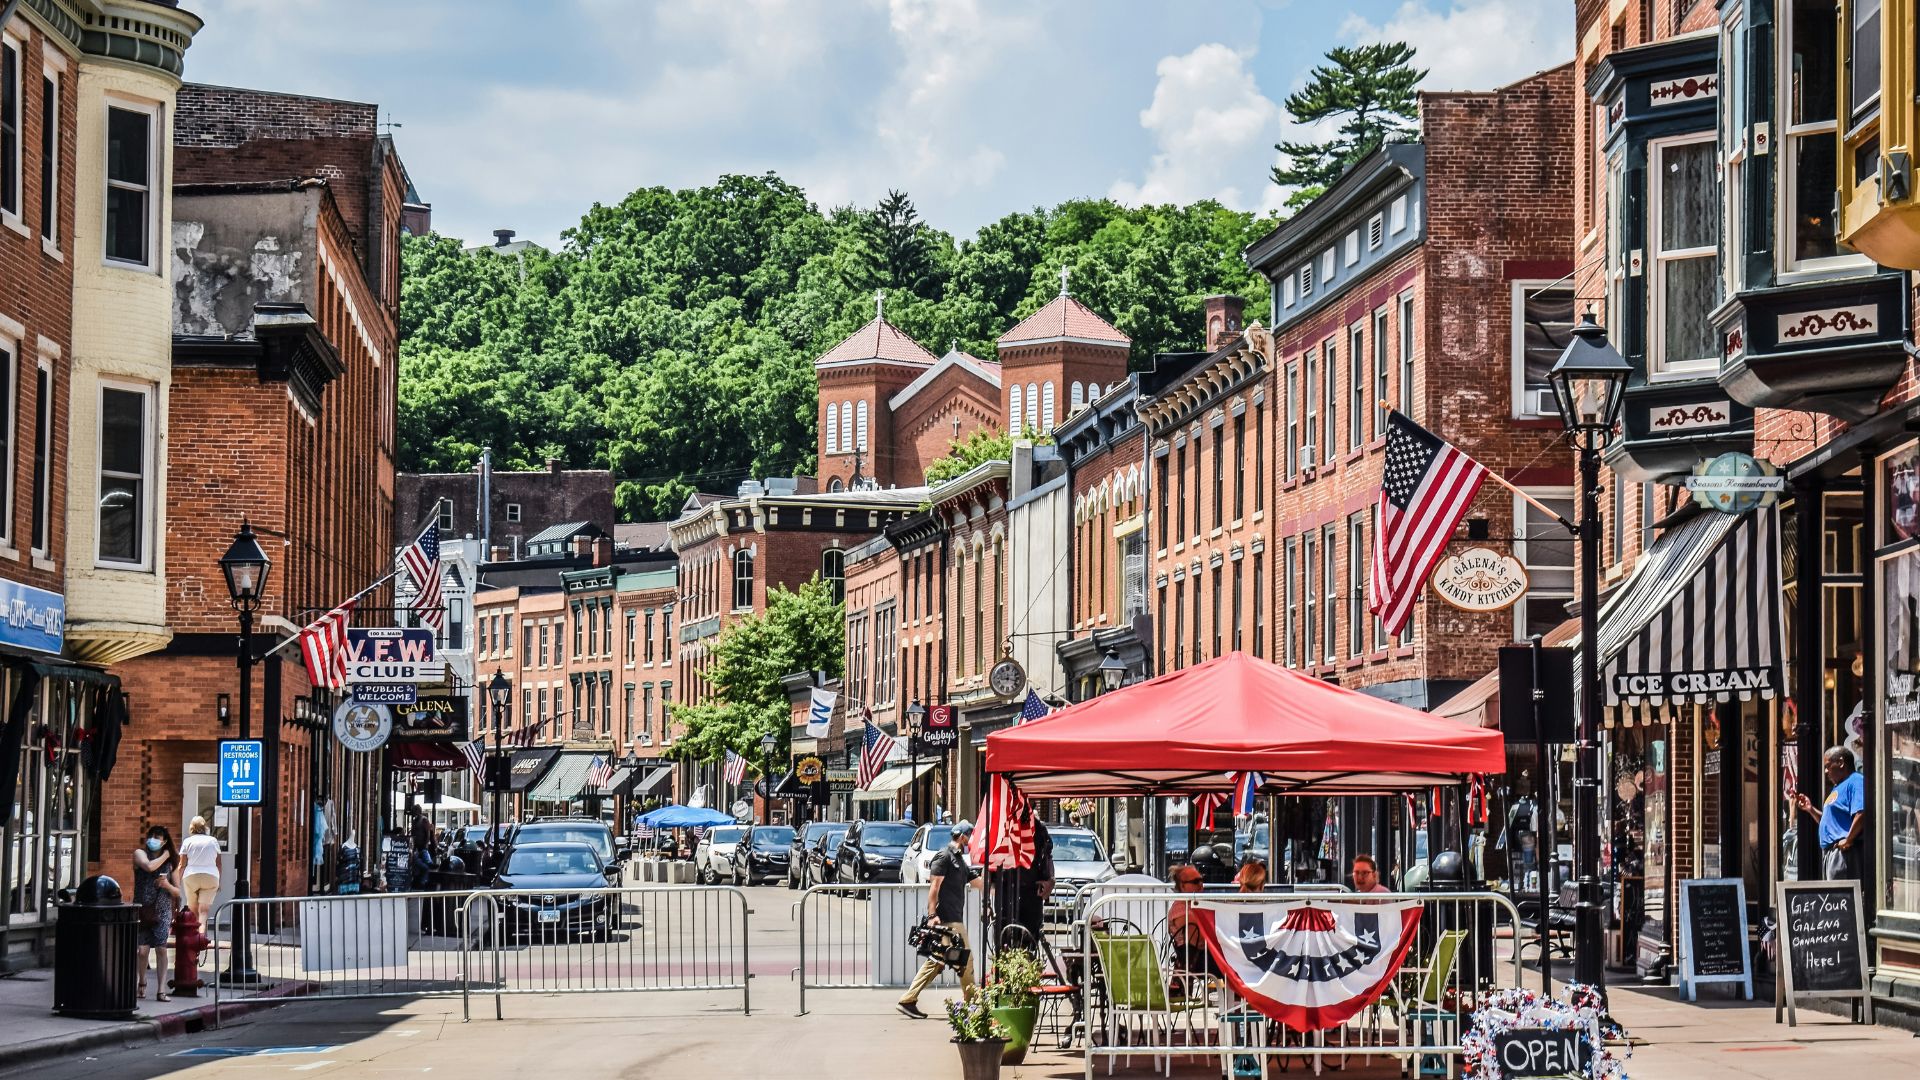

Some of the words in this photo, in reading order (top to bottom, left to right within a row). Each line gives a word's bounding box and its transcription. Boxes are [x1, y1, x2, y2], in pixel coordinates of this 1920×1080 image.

[1690, 478, 1722, 489] Seasons
[1723, 478, 1782, 489] Remembered
[1453, 557, 1507, 577] GALENA'S
[1439, 578, 1474, 604] KANDY
[1477, 578, 1522, 605] KITCHEN
[356, 665, 415, 678] CLUB
[365, 685, 404, 693] PUBLIC
[1618, 675, 1664, 694] ICE
[1671, 669, 1770, 693] CREAM
[358, 693, 411, 701] WELCOME
[397, 701, 454, 715] GALENA
[340, 732, 385, 750] TREASURES
[924, 729, 957, 745] Gabby's
[403, 758, 430, 767] VINTAGE
[432, 759, 454, 767] SODAS
[1791, 895, 1817, 915] GET
[1818, 893, 1848, 913] YOUR
[1792, 919, 1841, 932] GALENA
[1792, 932, 1849, 948] ORNAMENTS
[1503, 1030, 1580, 1072] OPEN
